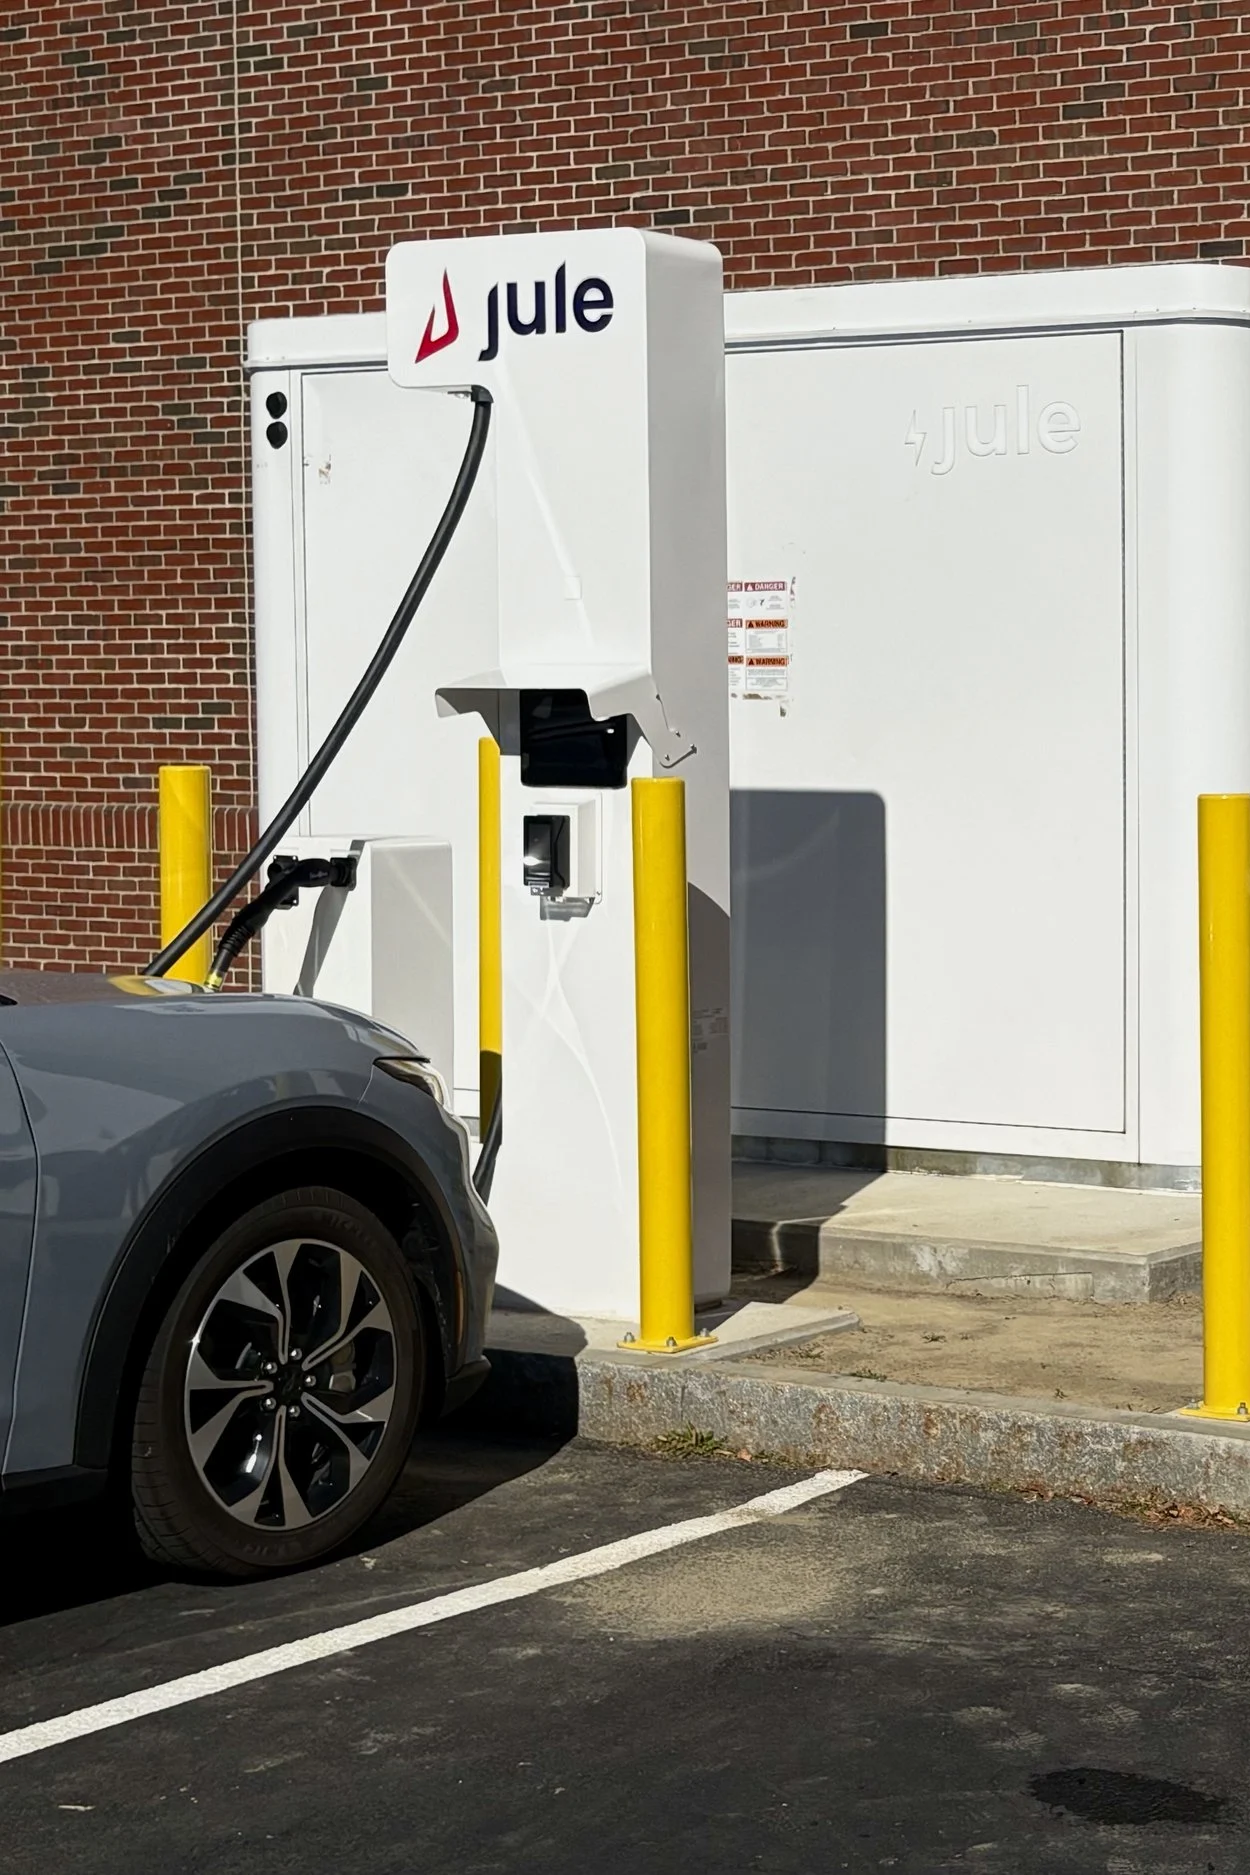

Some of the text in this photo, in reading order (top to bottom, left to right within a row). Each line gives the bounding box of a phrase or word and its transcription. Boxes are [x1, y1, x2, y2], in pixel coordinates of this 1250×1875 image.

[478, 260, 614, 361] jule
[931, 385, 1080, 475] jule
[756, 582, 783, 591] DANGER
[755, 620, 784, 628] WARNING
[755, 658, 784, 666] WARNING
